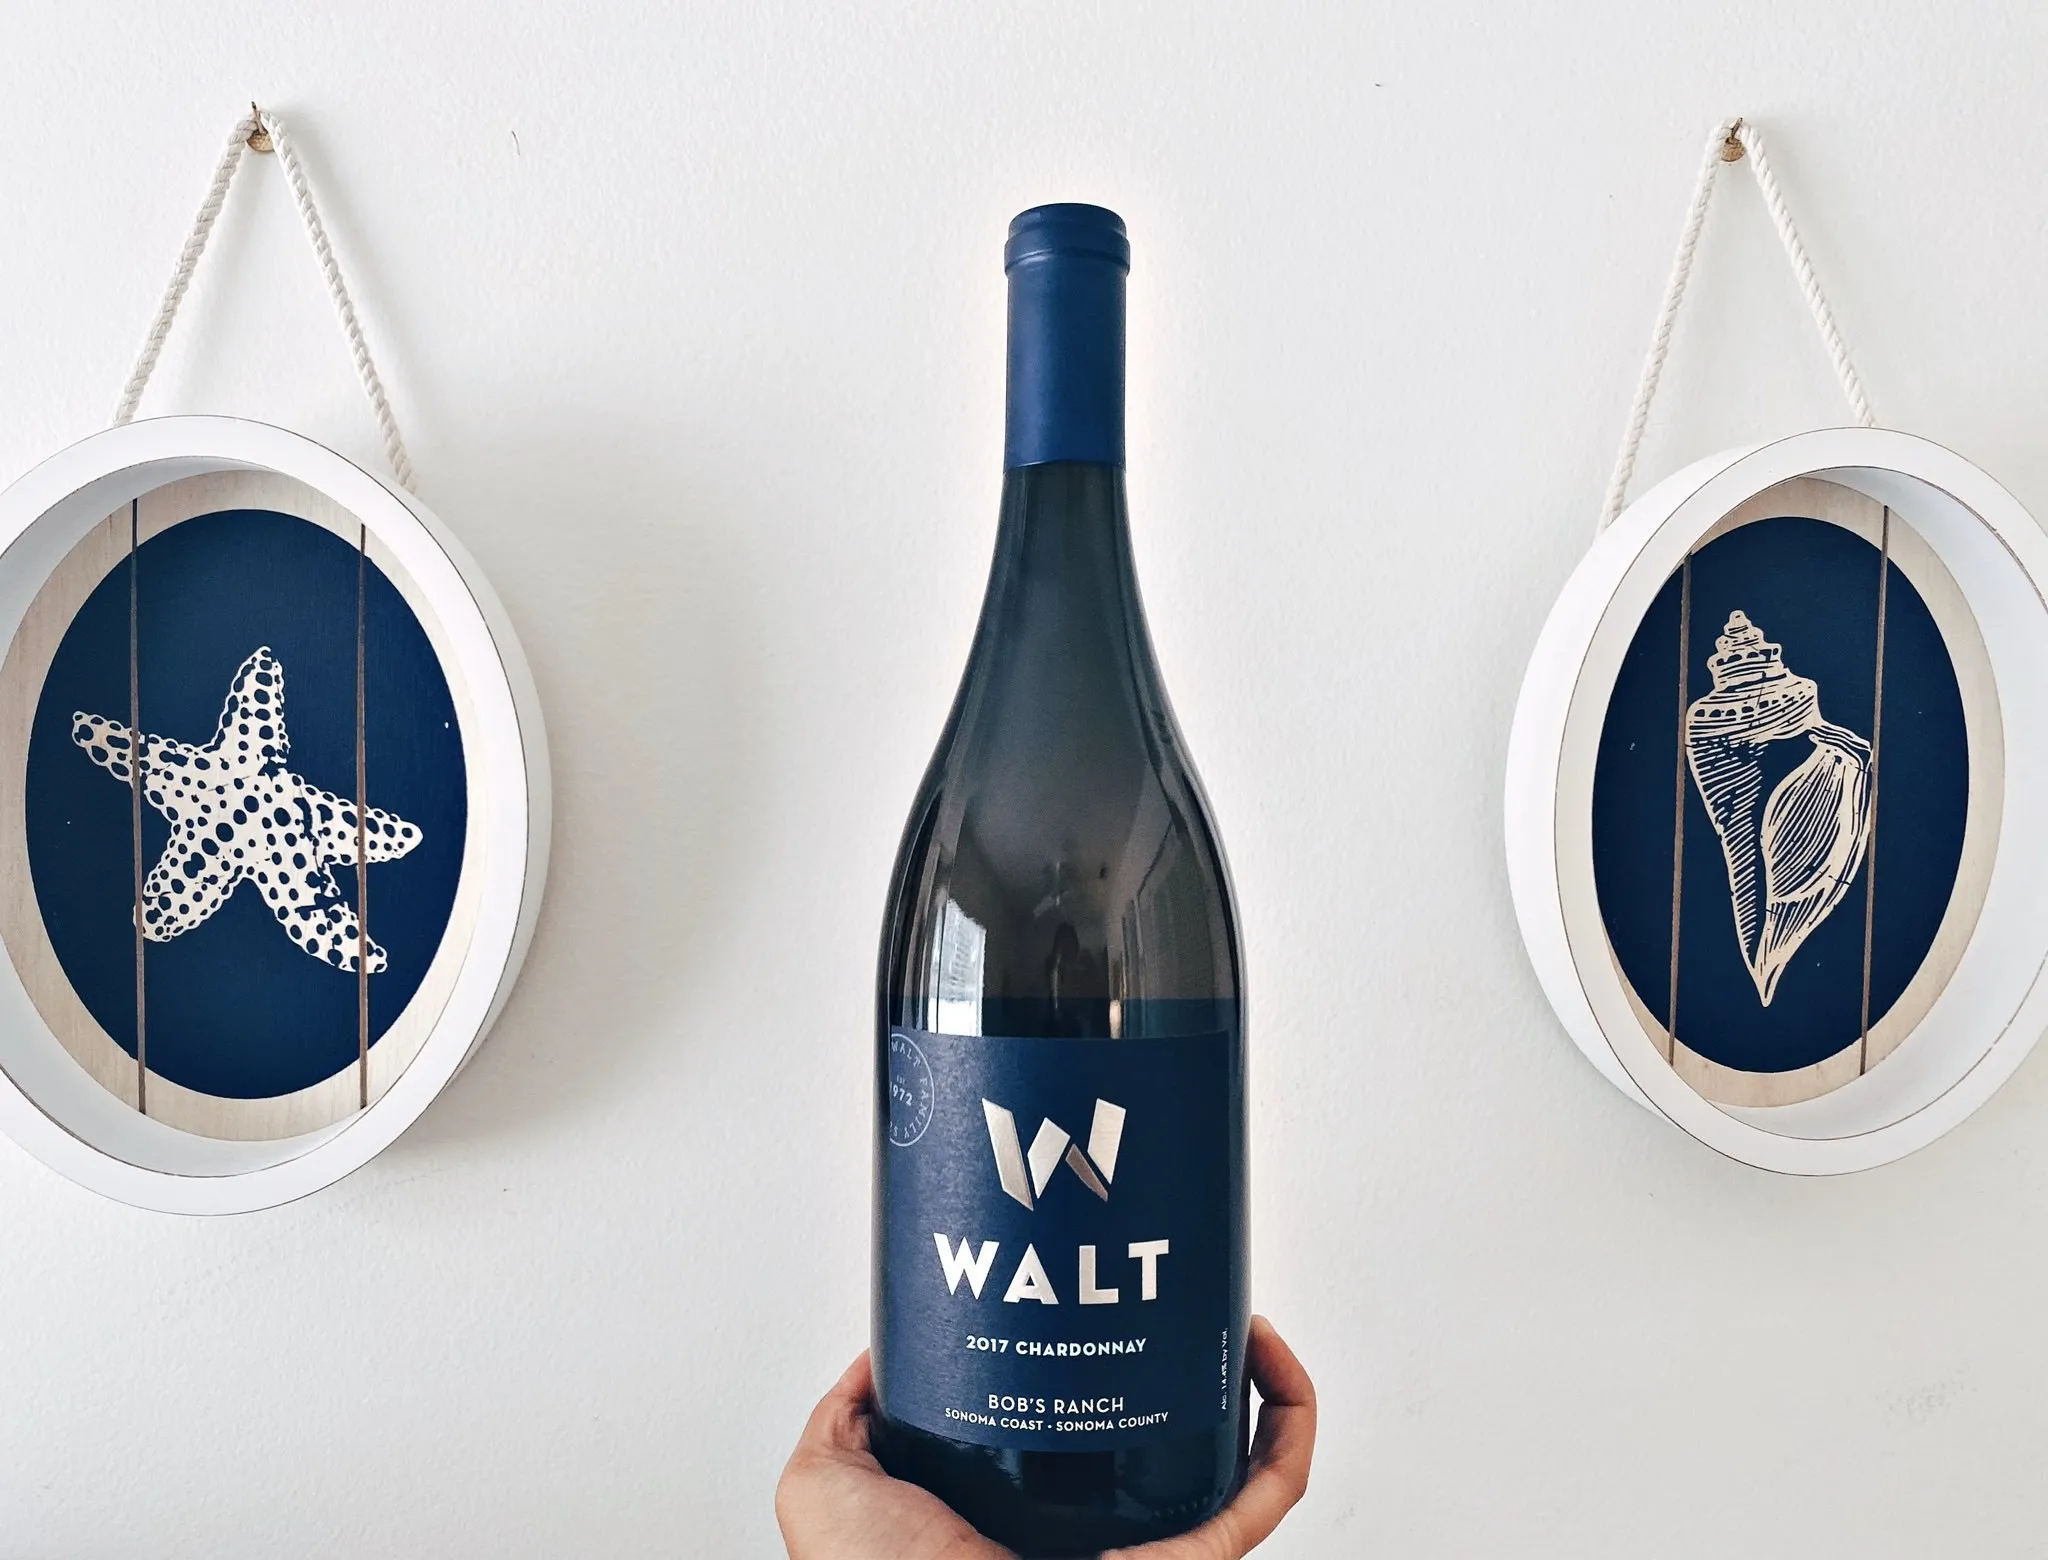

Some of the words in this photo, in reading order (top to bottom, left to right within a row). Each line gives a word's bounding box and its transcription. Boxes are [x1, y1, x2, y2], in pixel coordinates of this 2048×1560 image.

[904, 1078, 930, 1140] FAMILY
[933, 1232, 1169, 1305] WALT
[966, 1335, 1010, 1354] 2017
[1015, 1338, 1147, 1357] CHARDONNAY
[988, 1394, 1046, 1414] BOB'S
[1054, 1396, 1124, 1414] RANCH
[945, 1407, 997, 1427] SONOMA
[1000, 1417, 1044, 1431] COAST
[1056, 1419, 1114, 1432] SONOMA
[1118, 1411, 1169, 1429] COUNTY
